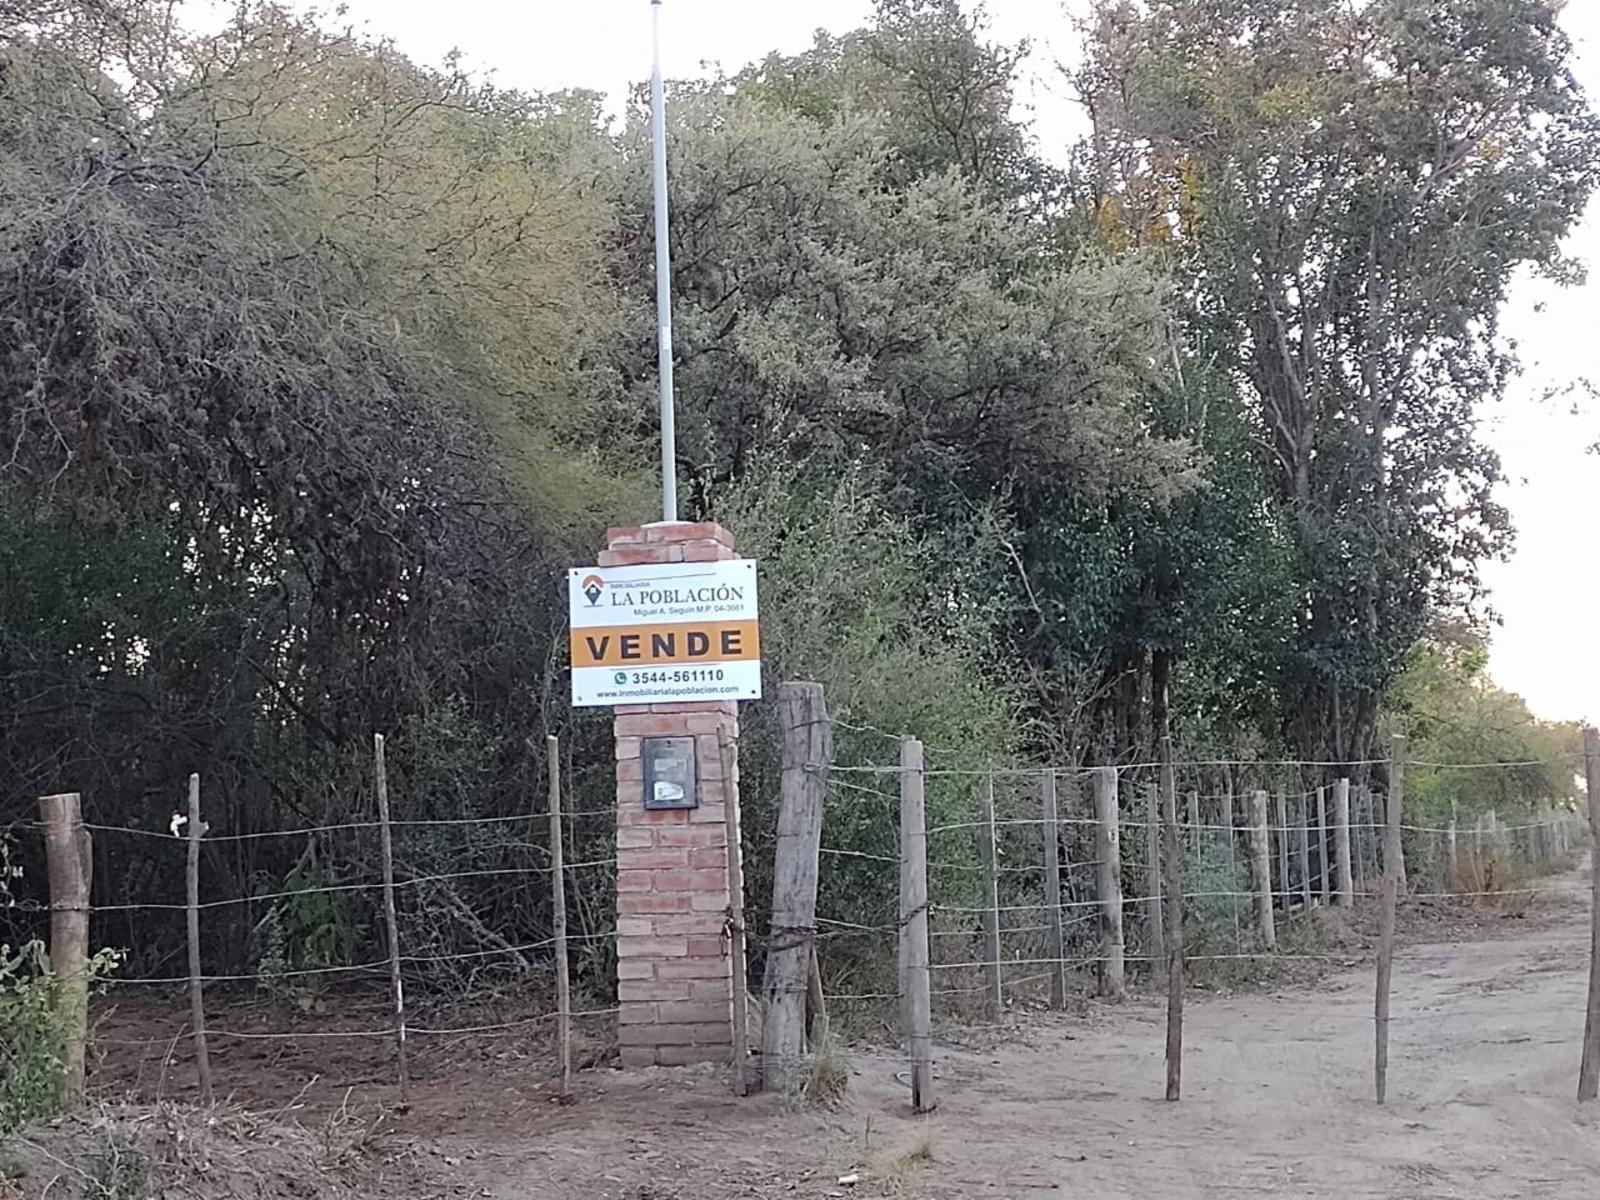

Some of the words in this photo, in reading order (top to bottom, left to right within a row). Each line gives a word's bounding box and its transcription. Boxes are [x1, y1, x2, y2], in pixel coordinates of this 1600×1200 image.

[611, 592, 634, 606] LA
[639, 583, 743, 605] POBLACIÓN
[633, 607, 658, 617] Miguel
[586, 630, 743, 661] VENDE
[632, 670, 724, 685] 3544-561110
